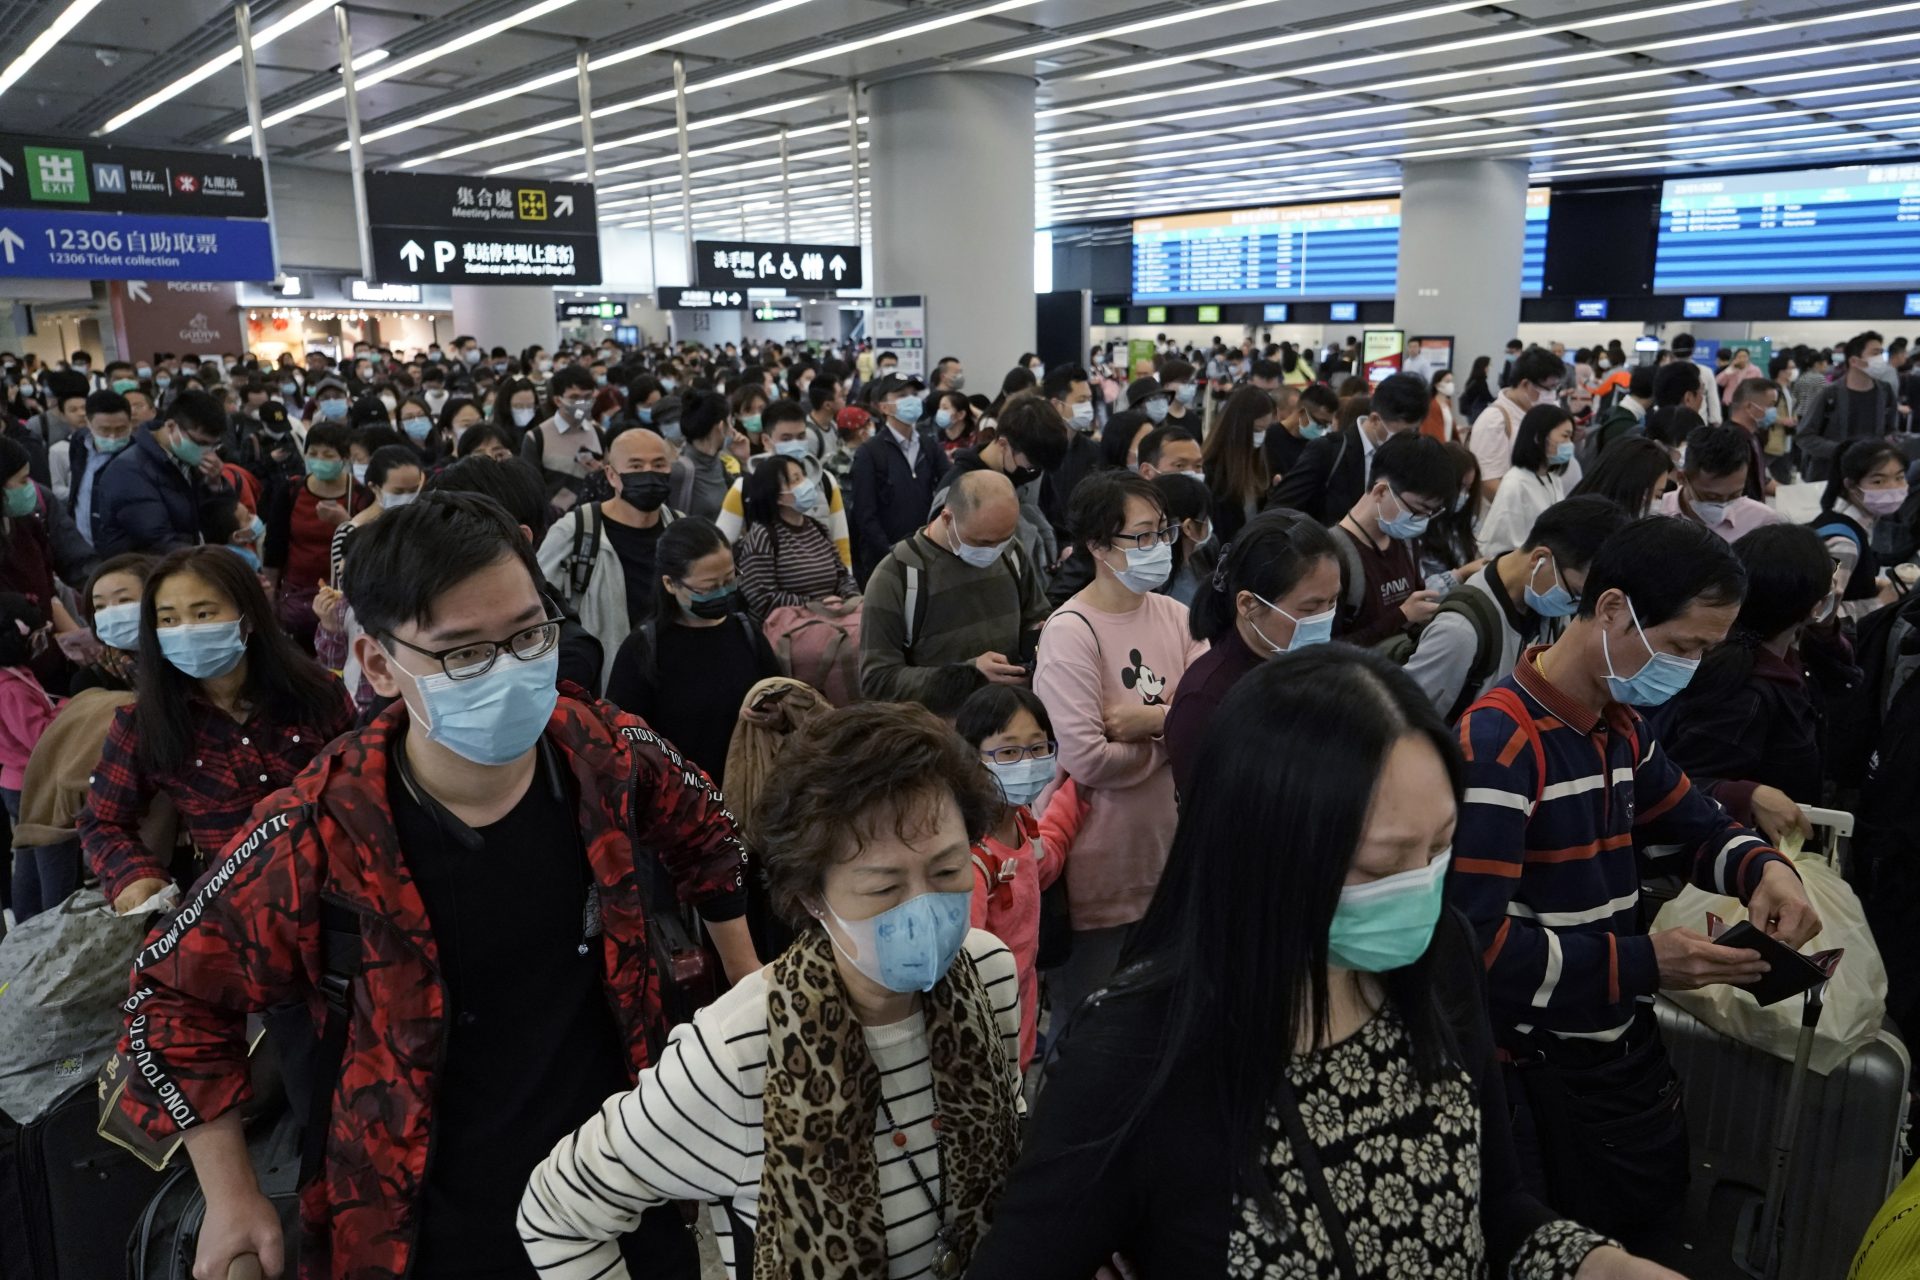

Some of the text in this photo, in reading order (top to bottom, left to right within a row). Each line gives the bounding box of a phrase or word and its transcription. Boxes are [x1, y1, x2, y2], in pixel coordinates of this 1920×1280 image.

[38, 155, 74, 182] 出
[42, 181, 75, 194] EXIT
[457, 186, 513, 208] 集合處
[452, 206, 514, 221] Meeting Point
[45, 228, 218, 254] 12306 自助取票
[49, 252, 180, 267] 12306 Ticket collection
[433, 240, 456, 273] P
[179, 328, 220, 340] GODIVA
[204, 858, 235, 899] TONG
[234, 822, 268, 866] TOUY
[158, 1082, 195, 1130] TONG
